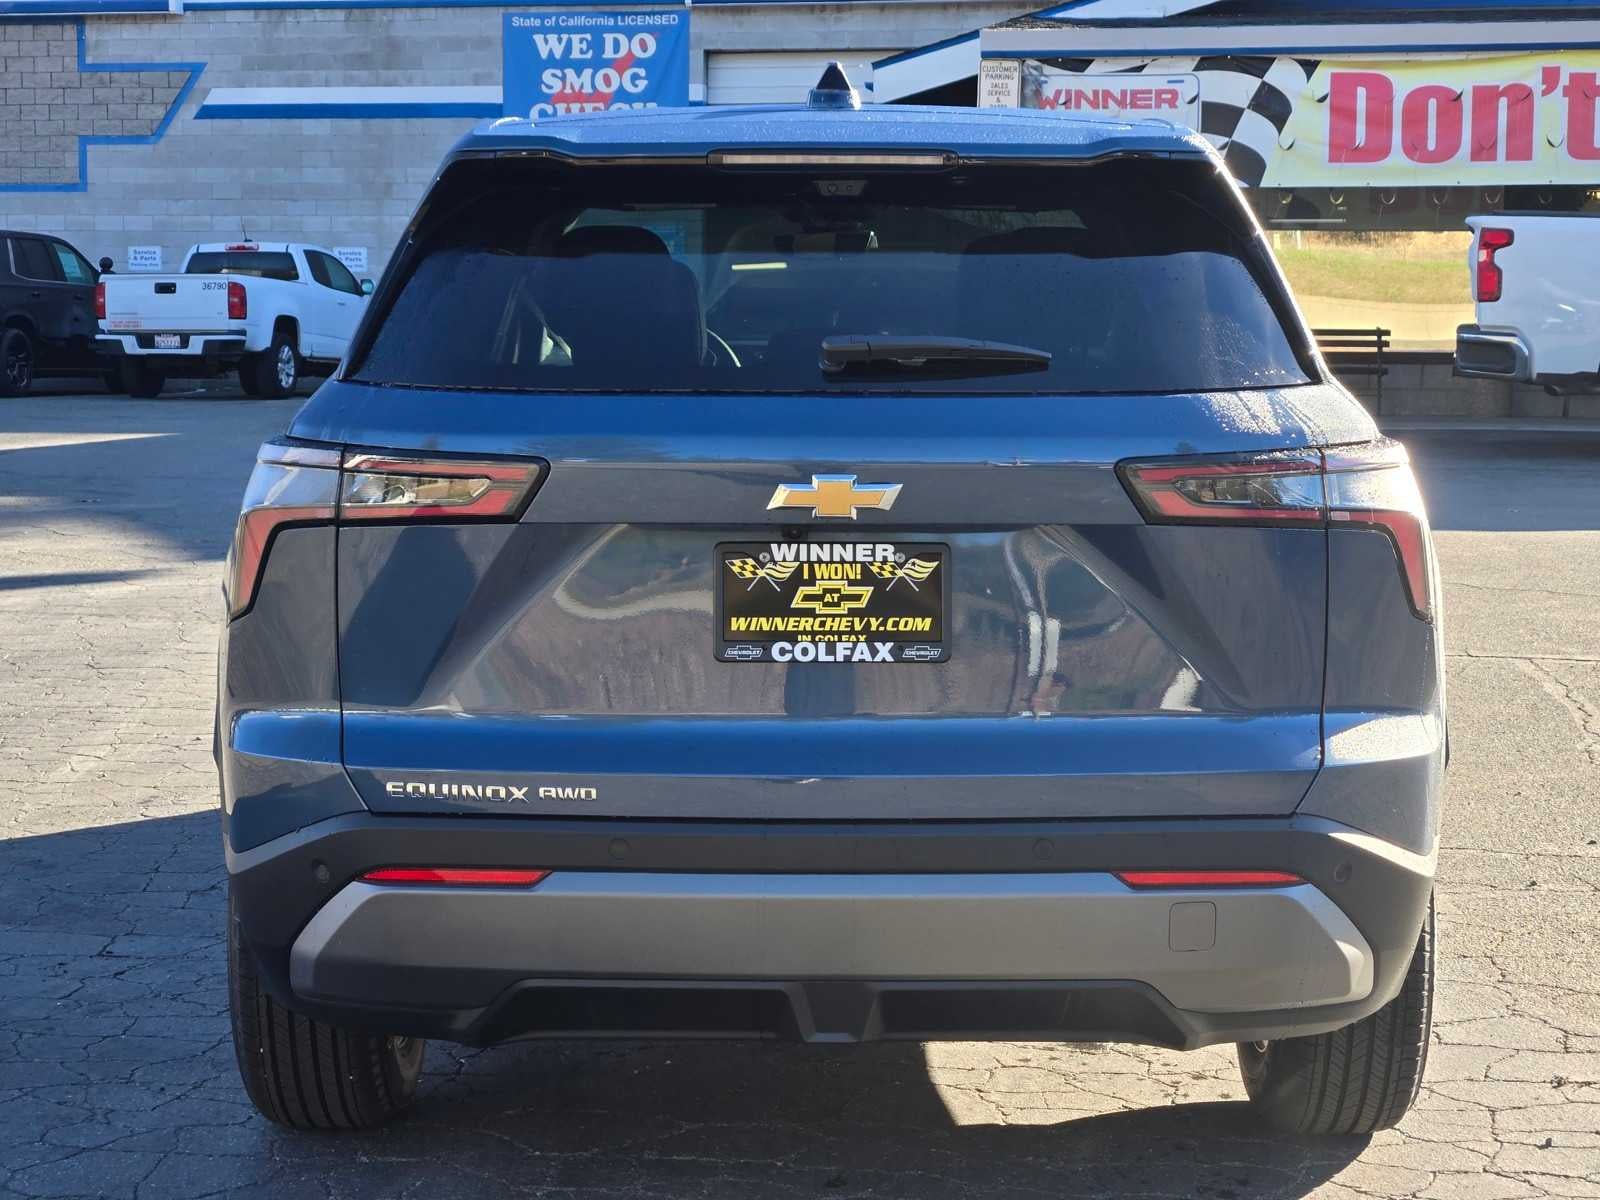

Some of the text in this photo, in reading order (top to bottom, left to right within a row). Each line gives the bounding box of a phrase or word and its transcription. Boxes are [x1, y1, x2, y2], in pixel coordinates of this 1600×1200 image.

[512, 14, 679, 27] State of California LICENSED
[532, 32, 657, 60] WE DO
[982, 65, 1018, 73] CUSTOMER
[541, 68, 648, 94] SMOG
[1035, 88, 1179, 110] WINNER
[1327, 65, 1600, 164] Don't
[202, 281, 227, 290] 36790
[770, 543, 895, 562] WINNER
[803, 563, 862, 580] I WON!
[823, 593, 841, 603] AT
[730, 616, 932, 631] WINNERCHEVY.COM
[771, 641, 895, 663] COLFAX
[386, 781, 597, 802] EQUINOX AWD
